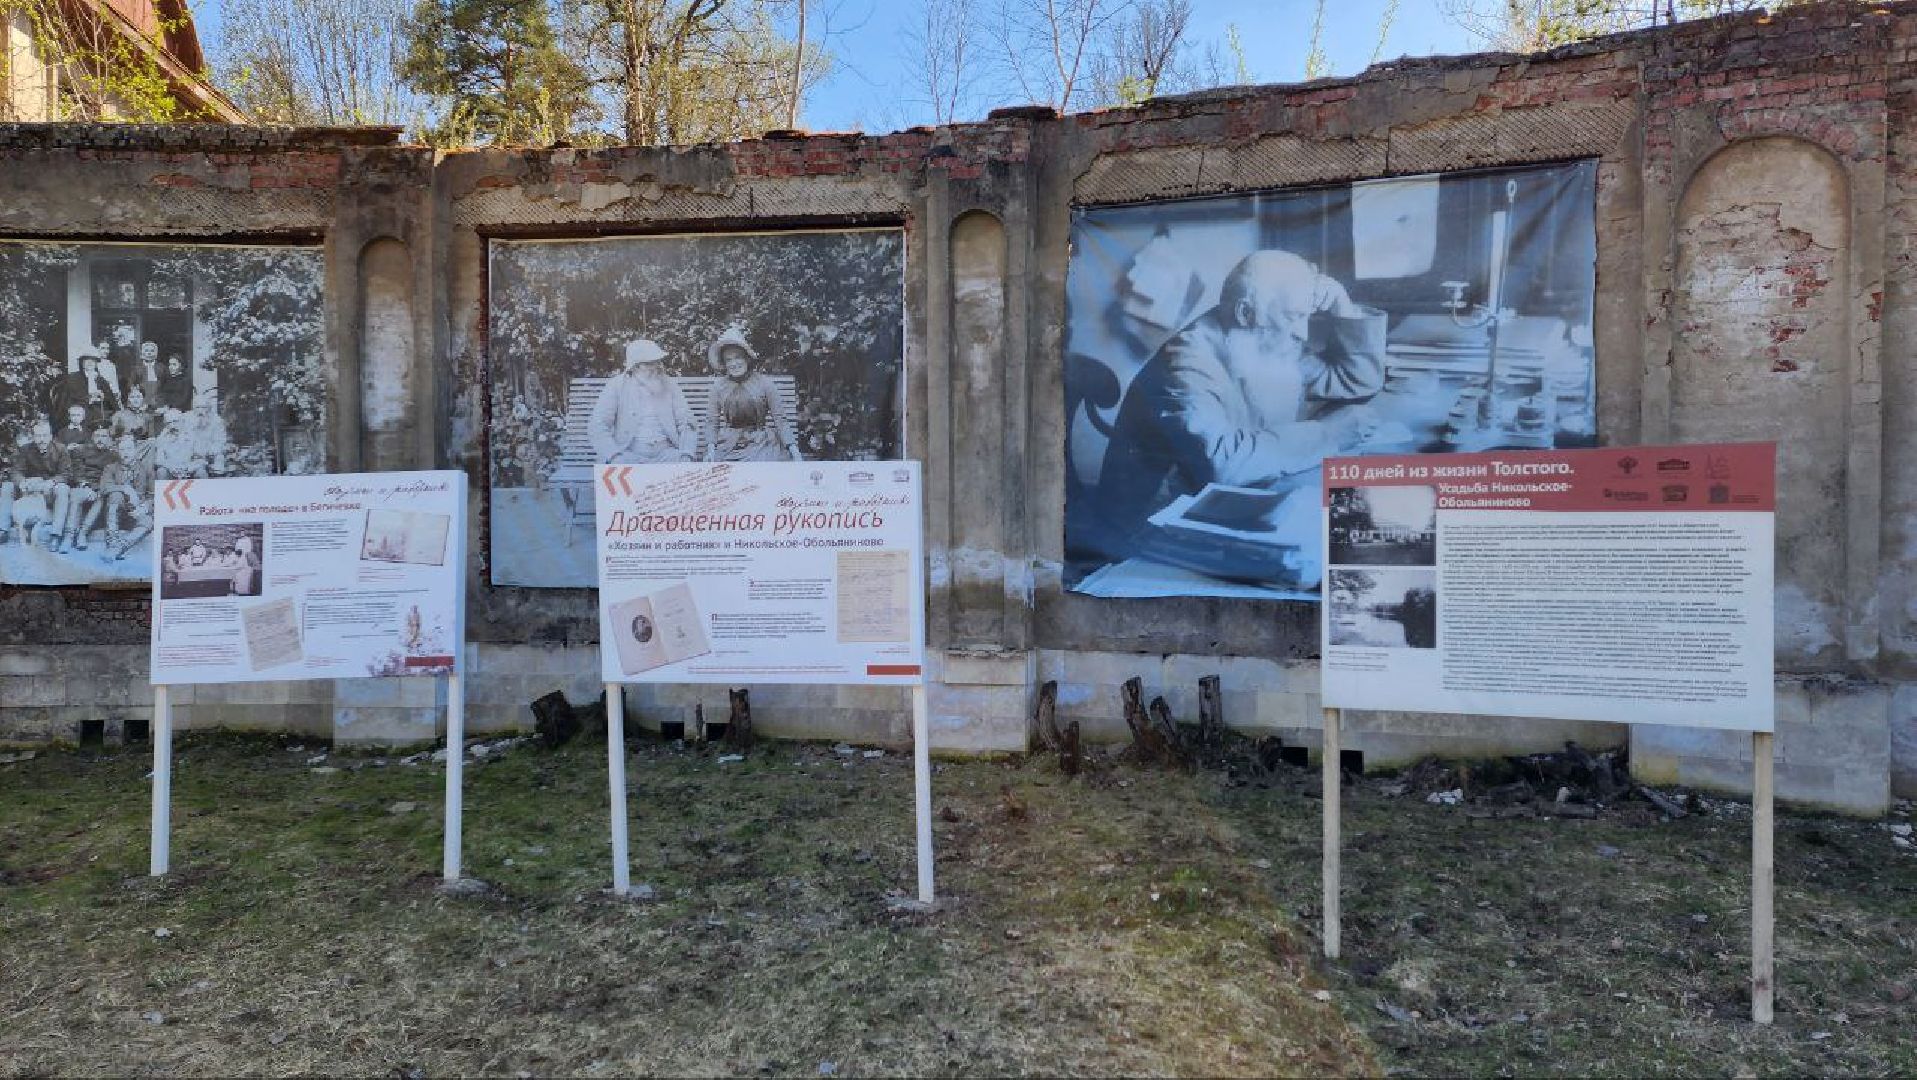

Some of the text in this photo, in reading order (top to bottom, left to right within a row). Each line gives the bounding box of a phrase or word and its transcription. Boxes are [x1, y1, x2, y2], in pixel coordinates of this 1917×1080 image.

[1329, 461, 1575, 480] 110 дней из жизни Толстого.
[1439, 482, 1573, 494] Усадьба Никольское-
[605, 510, 883, 537] Драгоценная рукопись
[734, 538, 884, 549] Никольское-Обольяниново
